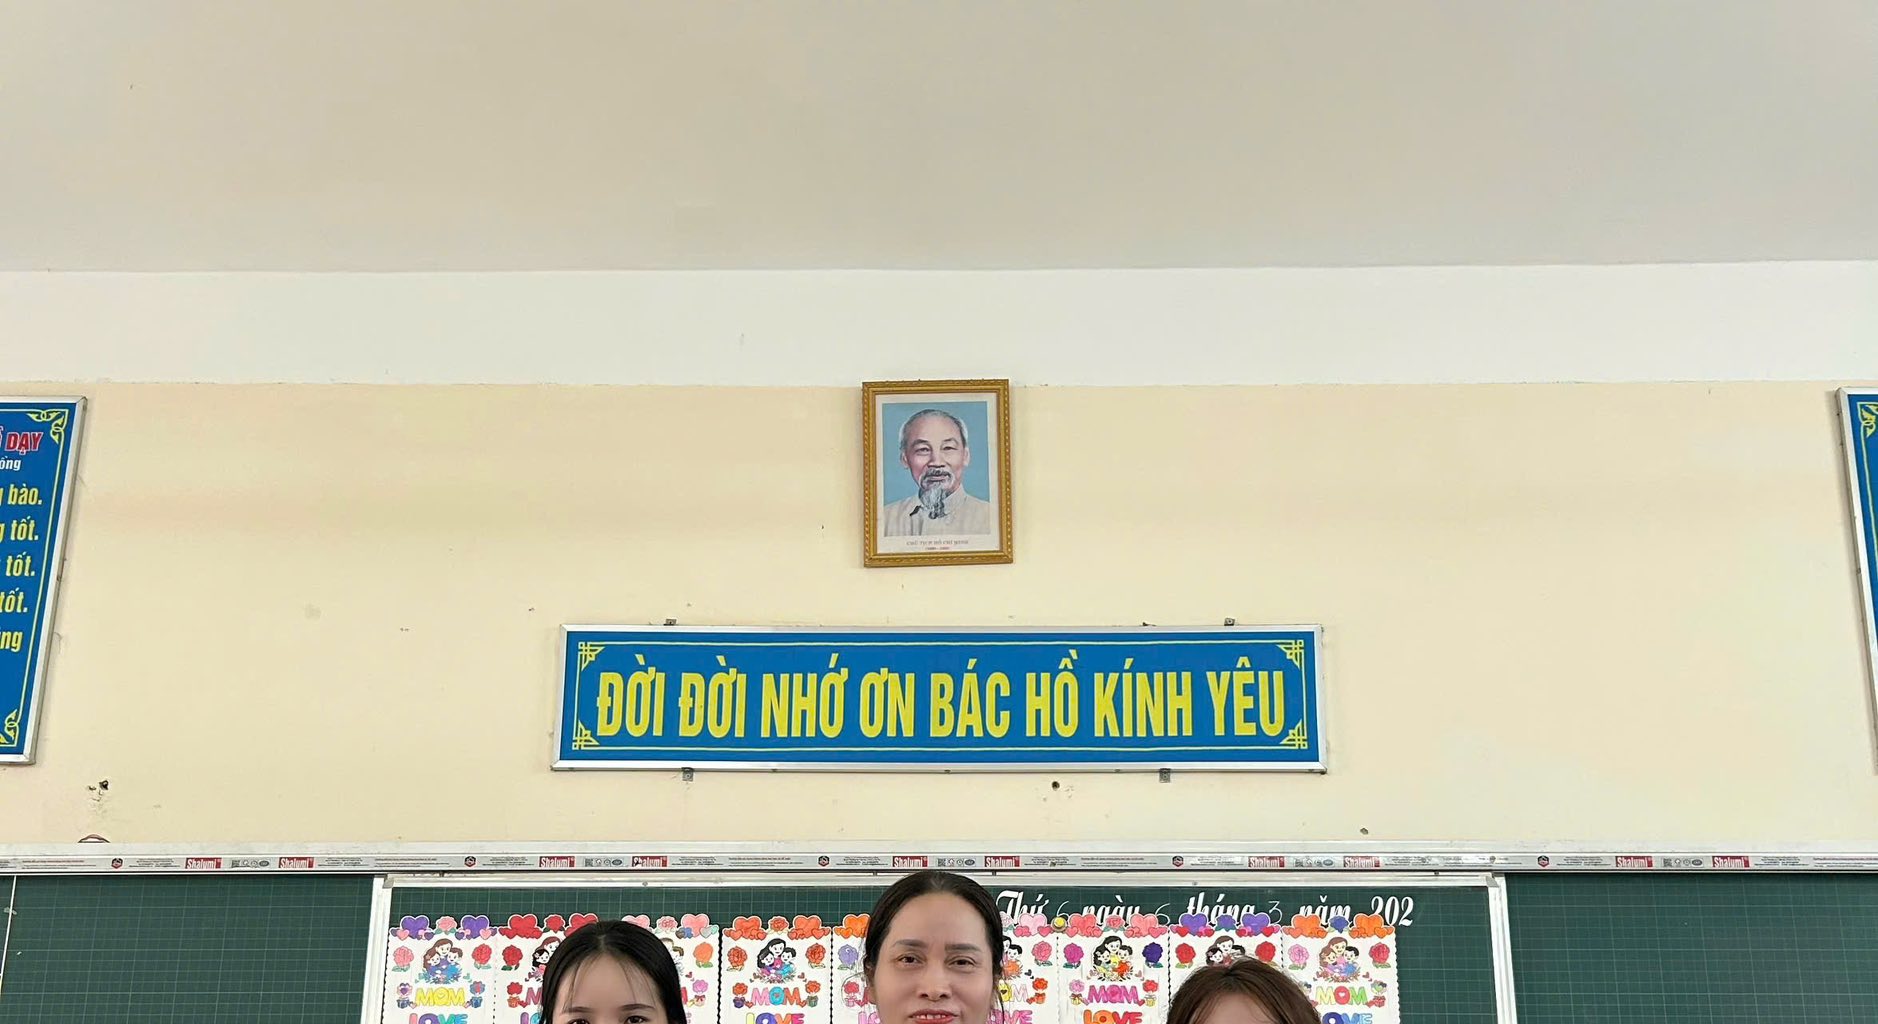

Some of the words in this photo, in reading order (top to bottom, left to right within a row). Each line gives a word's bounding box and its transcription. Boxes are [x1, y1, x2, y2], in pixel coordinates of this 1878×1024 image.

[5, 431, 43, 455] DẠY
[0, 455, 21, 471] ồng
[8, 483, 42, 505] bào.
[10, 515, 39, 541] tốt.
[6, 551, 35, 577] tốt.
[0, 630, 23, 653] ng
[597, 654, 666, 737] ĐỜI
[678, 655, 747, 738] ĐỜI
[761, 653, 849, 738] NHỚ
[859, 667, 915, 738] ƠN
[929, 658, 1011, 738] BÁC
[1025, 649, 1079, 737] HỒ
[1093, 657, 1193, 737] KÍNH
[1205, 656, 1285, 737] YÊU
[996, 890, 1049, 924] Thứ
[1155, 902, 1171, 925] 6
[1268, 900, 1283, 925] 3
[1371, 896, 1414, 926] 202
[415, 987, 465, 1007] MOM
[751, 986, 801, 1007] MOM
[997, 979, 1028, 1003] OM
[1087, 984, 1139, 1004] MOM
[1316, 985, 1368, 1005] MOM
